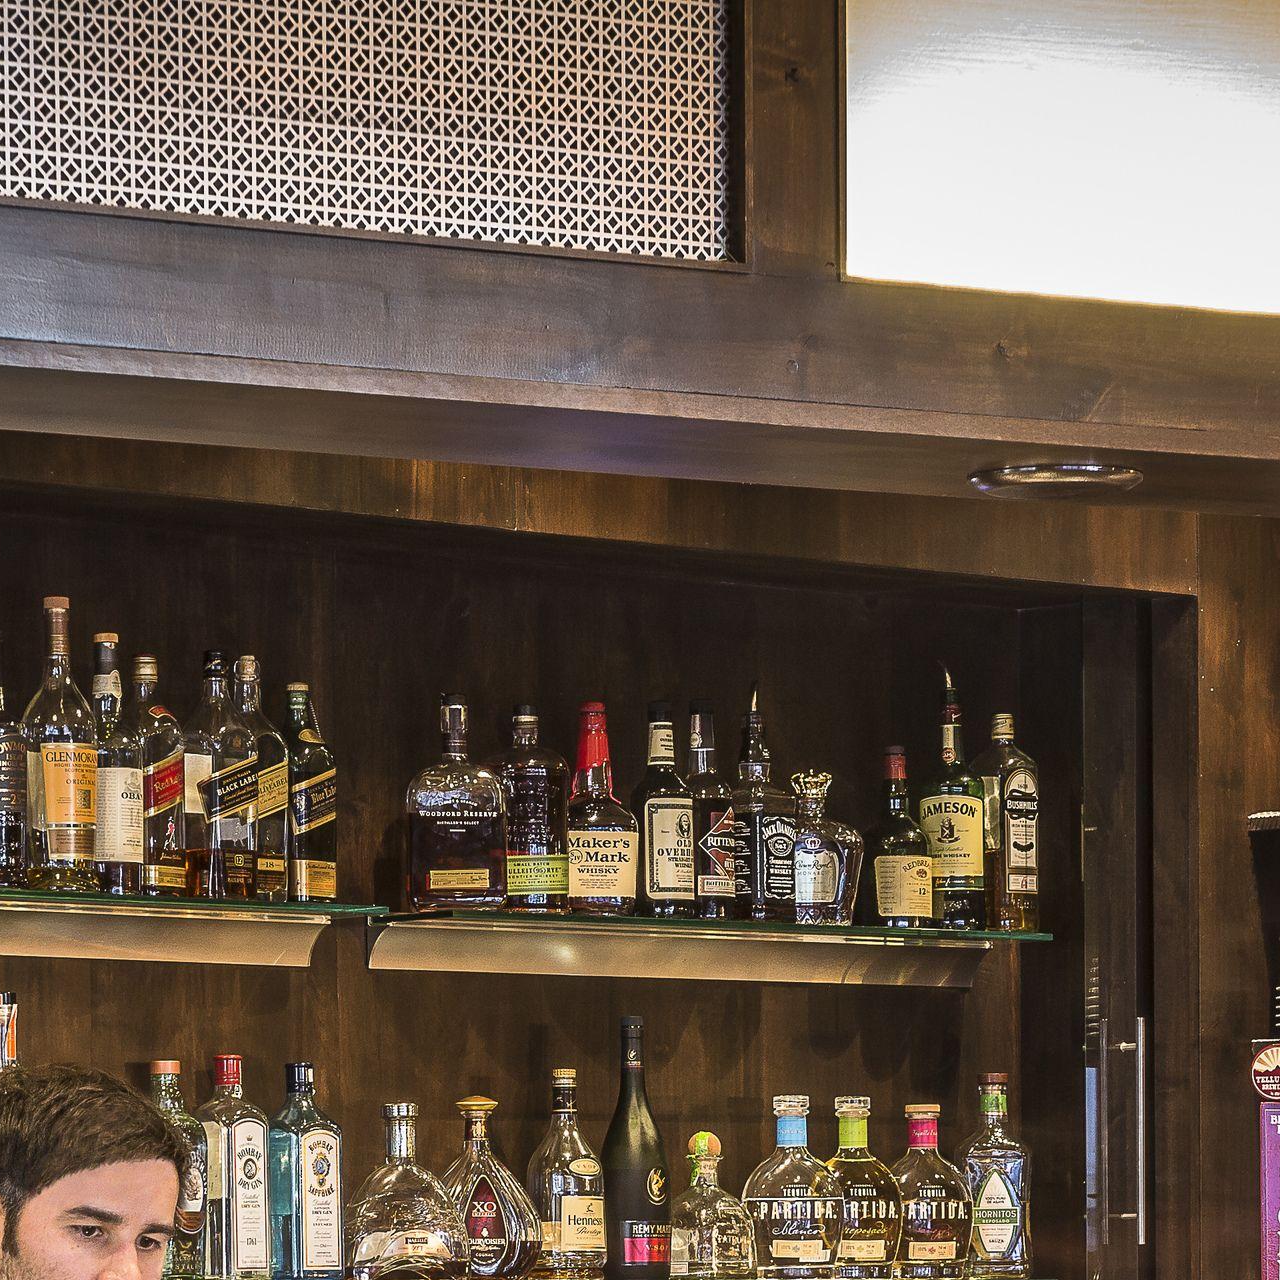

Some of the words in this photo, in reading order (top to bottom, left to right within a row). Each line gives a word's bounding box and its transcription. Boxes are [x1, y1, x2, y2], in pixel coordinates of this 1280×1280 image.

[217, 782, 238, 796] BLACK
[922, 802, 976, 819] JAMESON
[762, 824, 776, 840] JACK
[568, 838, 630, 848] Maker's
[919, 887, 926, 895] 12
[309, 1140, 334, 1154] BOMBAY
[237, 1148, 263, 1160] BOMBAY
[238, 1178, 250, 1190] DRY
[251, 1178, 263, 1190] GIN
[308, 1184, 335, 1197] SAPPHIRE
[783, 1188, 812, 1197] TEQUILA
[850, 1188, 877, 1197] TEQUILA
[919, 1189, 946, 1198] TEQUILA
[472, 1201, 497, 1213] XO
[975, 1210, 1017, 1218] HORNITOS
[632, 1223, 655, 1234] RÉMY
[772, 1221, 826, 1235] blanco
